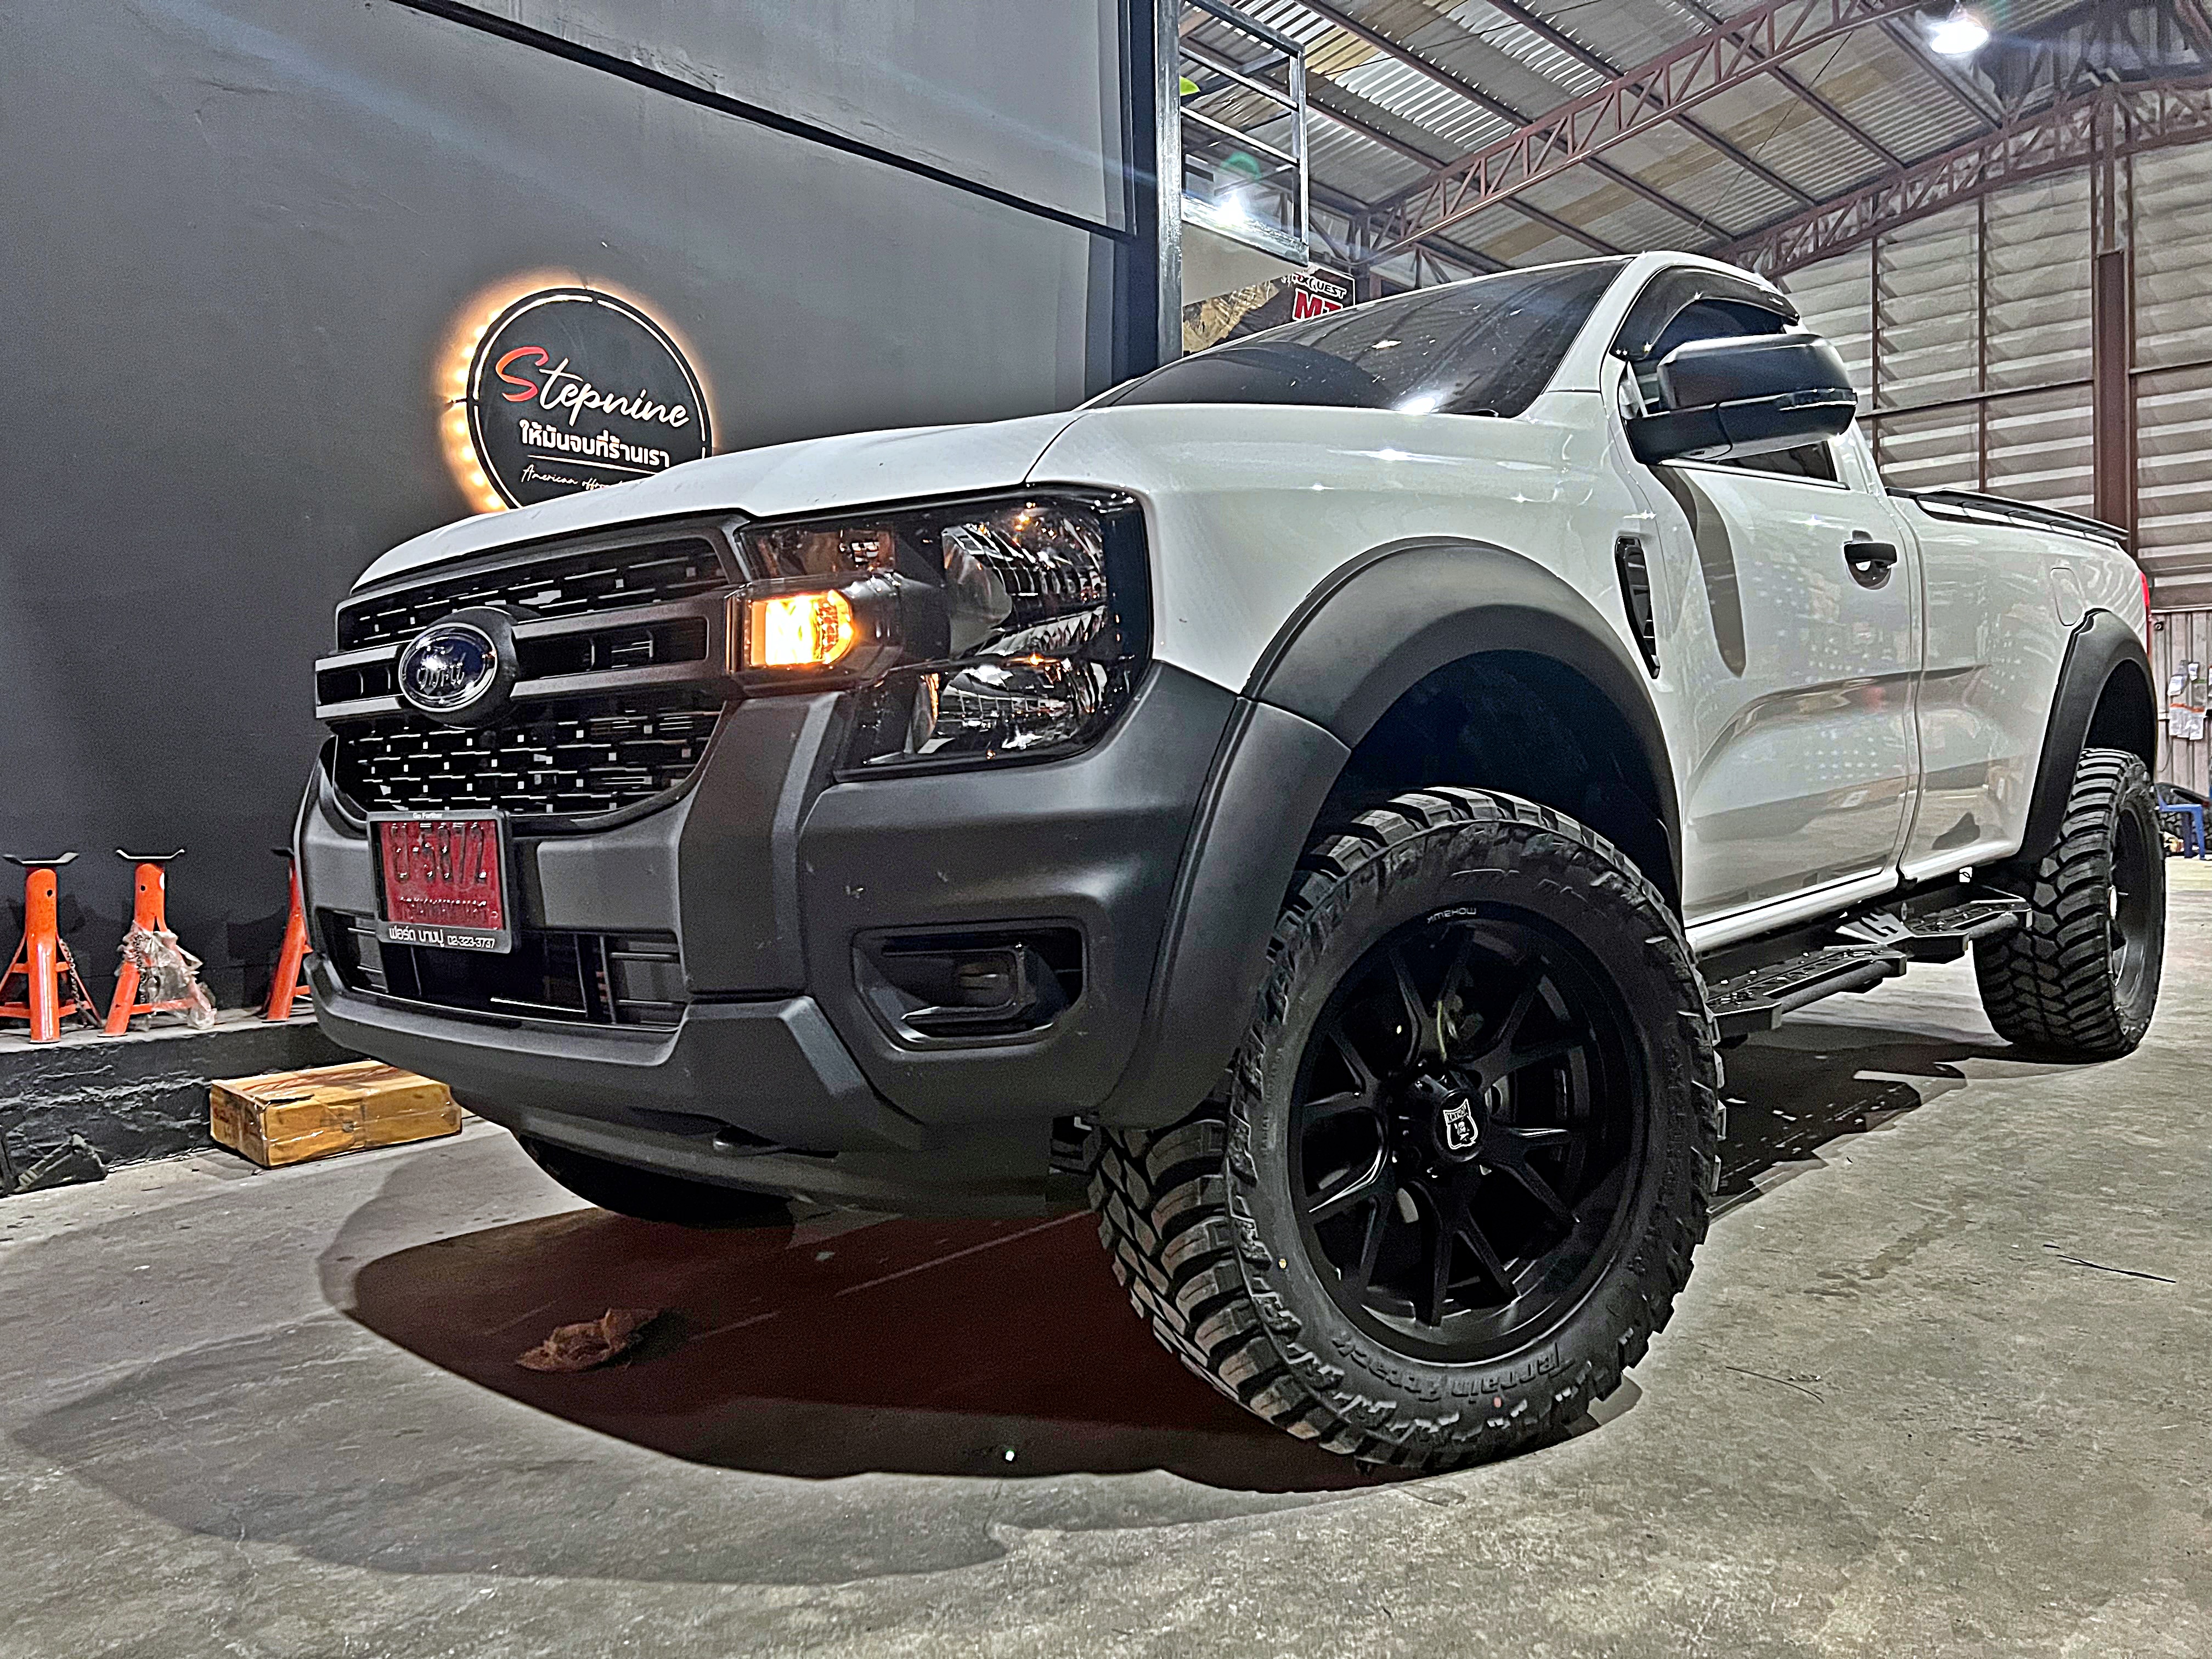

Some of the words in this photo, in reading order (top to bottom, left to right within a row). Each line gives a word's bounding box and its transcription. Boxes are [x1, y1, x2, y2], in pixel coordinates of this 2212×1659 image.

[496, 346, 689, 427] Stepnine
[519, 419, 670, 468] ให้มันจบที่ร้านเรา
[521, 464, 578, 483] American
[447, 935, 495, 949] 02-323-3737
